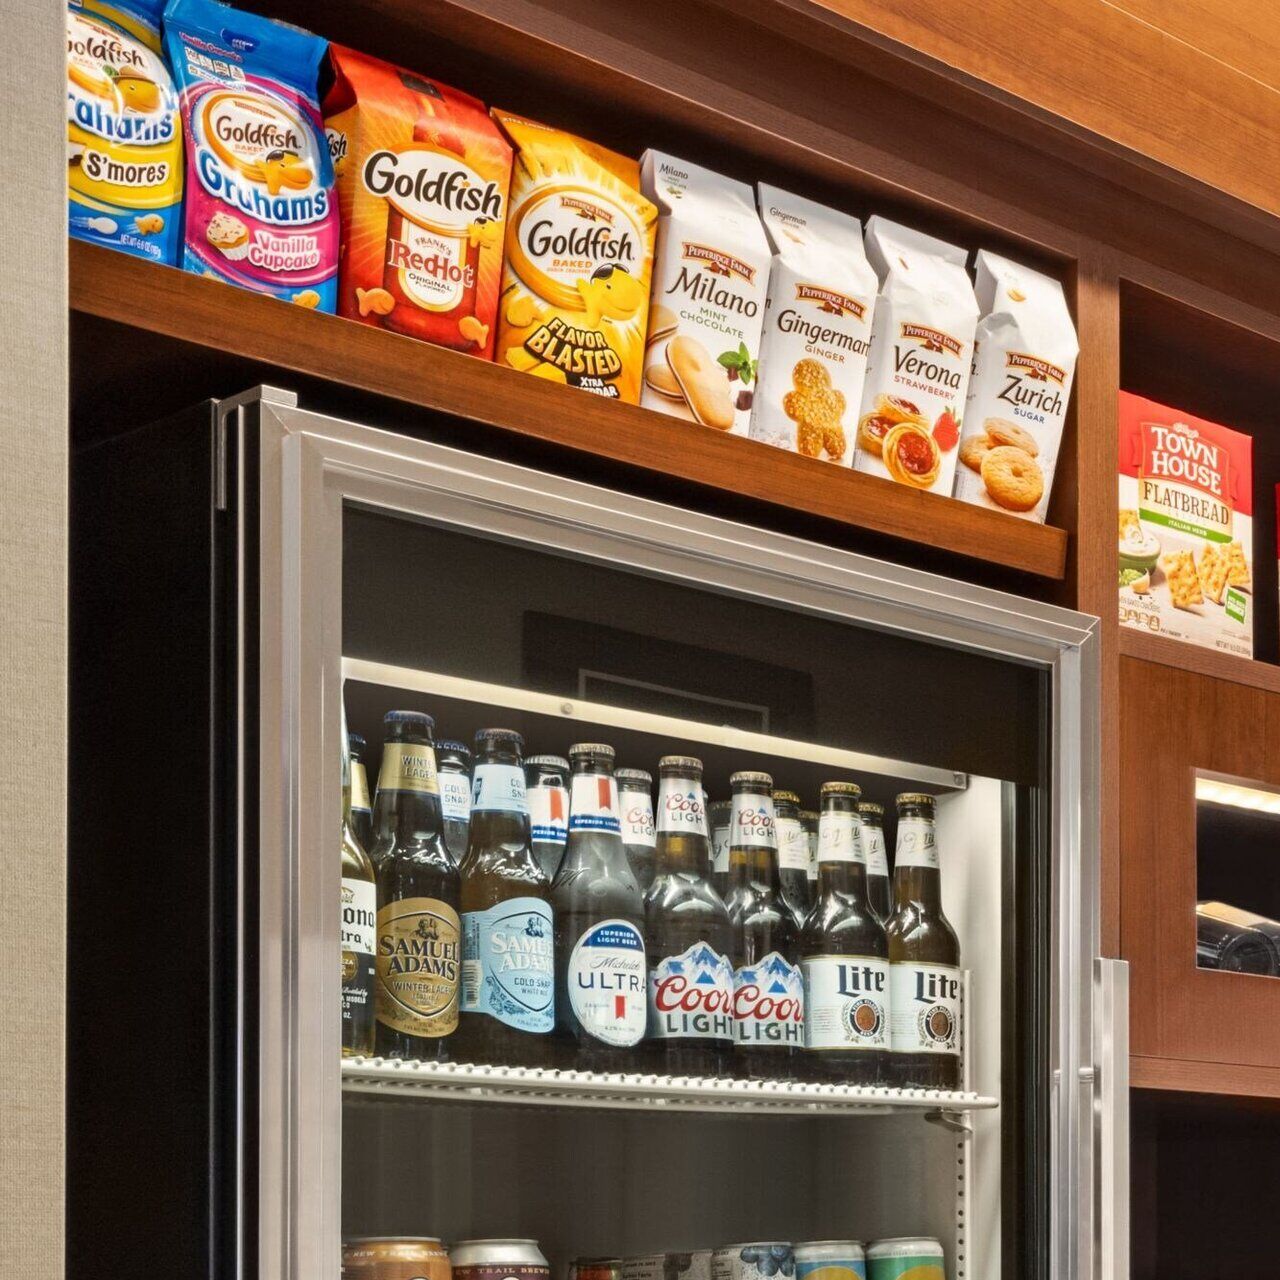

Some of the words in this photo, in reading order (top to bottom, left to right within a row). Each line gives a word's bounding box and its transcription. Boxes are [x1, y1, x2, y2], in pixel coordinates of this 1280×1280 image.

[215, 115, 299, 150] Goldfish
[87, 152, 167, 183] S'mores
[659, 162, 690, 180] Milano
[198, 150, 327, 220] Grahams
[364, 151, 502, 218] Goldfish
[257, 230, 315, 252] Vanilla
[415, 235, 453, 256] FRANK'S
[527, 220, 633, 260] Goldfish
[250, 248, 319, 269] Cupcake
[388, 239, 474, 287] RedHot
[552, 259, 594, 269] BAKED
[688, 246, 730, 269] PEPPERIDGE
[731, 258, 750, 277] FARM
[408, 272, 453, 292] ORIGINAL
[666, 267, 758, 318] Milano
[700, 307, 728, 322] MINT
[801, 286, 842, 307] PEPPERIDGE
[844, 298, 862, 315] FARM
[548, 317, 607, 348] FLAVOR
[680, 310, 744, 340] CHOCOLATE
[777, 309, 870, 357] Gingerman
[527, 326, 621, 377] BLASTED
[804, 344, 845, 364] GINGER
[580, 376, 604, 388] XTRA
[894, 345, 962, 390] Verona
[893, 374, 956, 401] STRAWBERRY
[998, 374, 1063, 417] Zurich
[1014, 407, 1046, 425] SUGAR
[1151, 426, 1218, 469] TOWN
[1152, 450, 1222, 496] HOUSE
[1143, 480, 1230, 526] FLATBREAD
[379, 935, 459, 962] SAMUEL
[597, 937, 617, 946] LIGHT
[619, 938, 637, 946] BEER
[599, 929, 635, 939] SUPERIOR
[387, 955, 458, 983] ADAMS
[836, 963, 885, 999] Lite
[914, 970, 958, 1005] Lite
